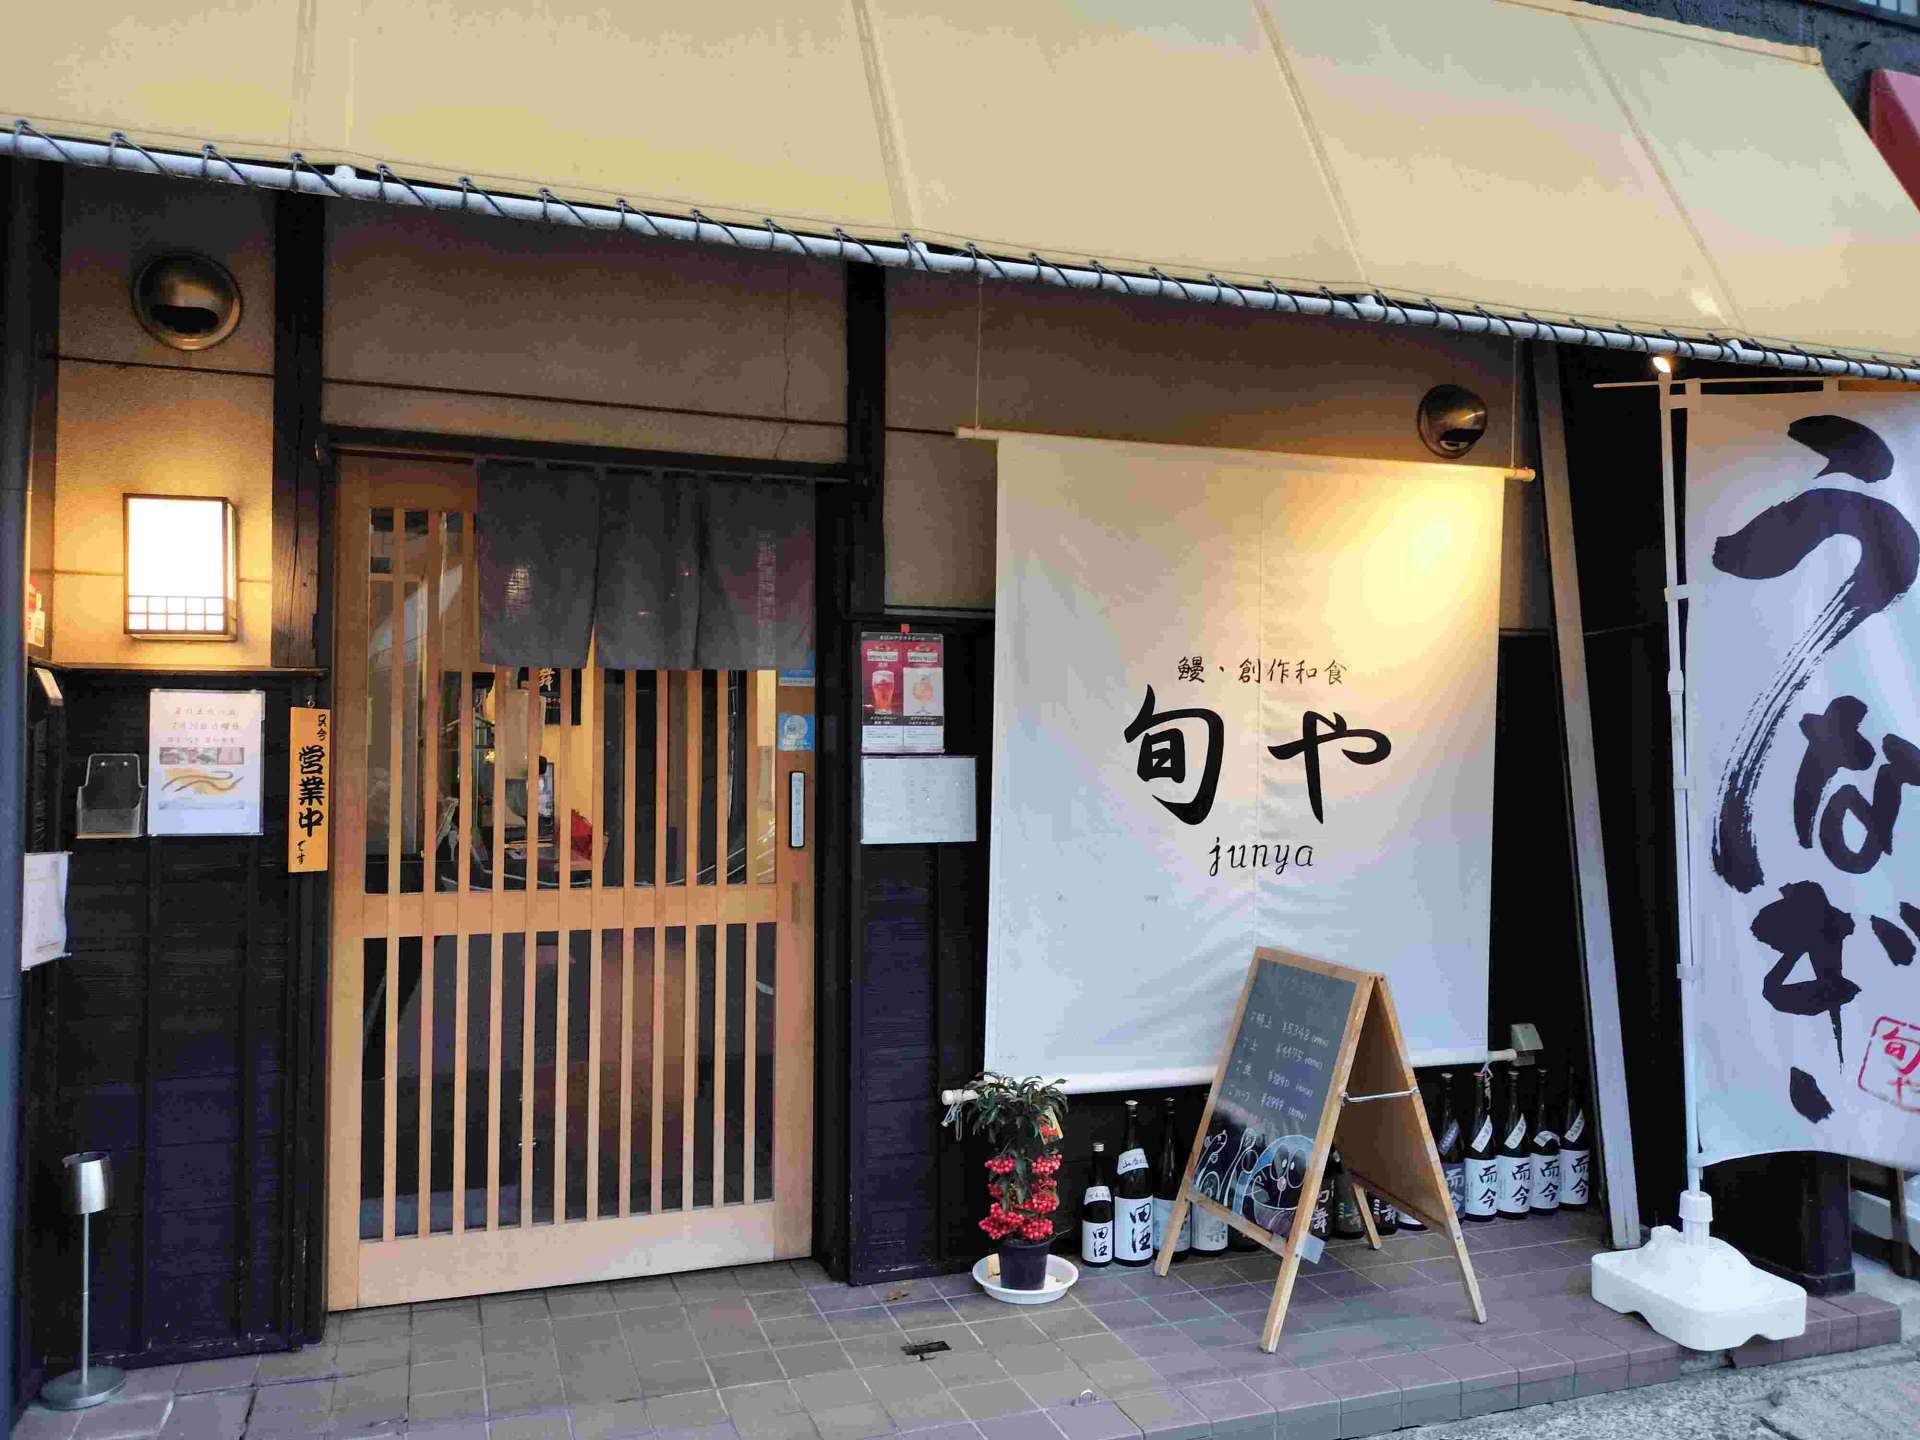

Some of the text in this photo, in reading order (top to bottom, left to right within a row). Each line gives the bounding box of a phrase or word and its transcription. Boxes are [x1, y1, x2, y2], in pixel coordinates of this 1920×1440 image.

[1177, 655, 1347, 685] 鰻、創作和食
[1124, 683, 1392, 825] 旬や
[1711, 413, 1920, 1124] うなぎ
[298, 744, 325, 838] 営業中
[296, 840, 306, 865] です
[1208, 836, 1314, 877] junya
[1478, 1164, 1497, 1209] 而今
[1511, 1162, 1531, 1206] 而今
[1539, 1159, 1560, 1201] 而今
[1570, 1154, 1589, 1198] 而今
